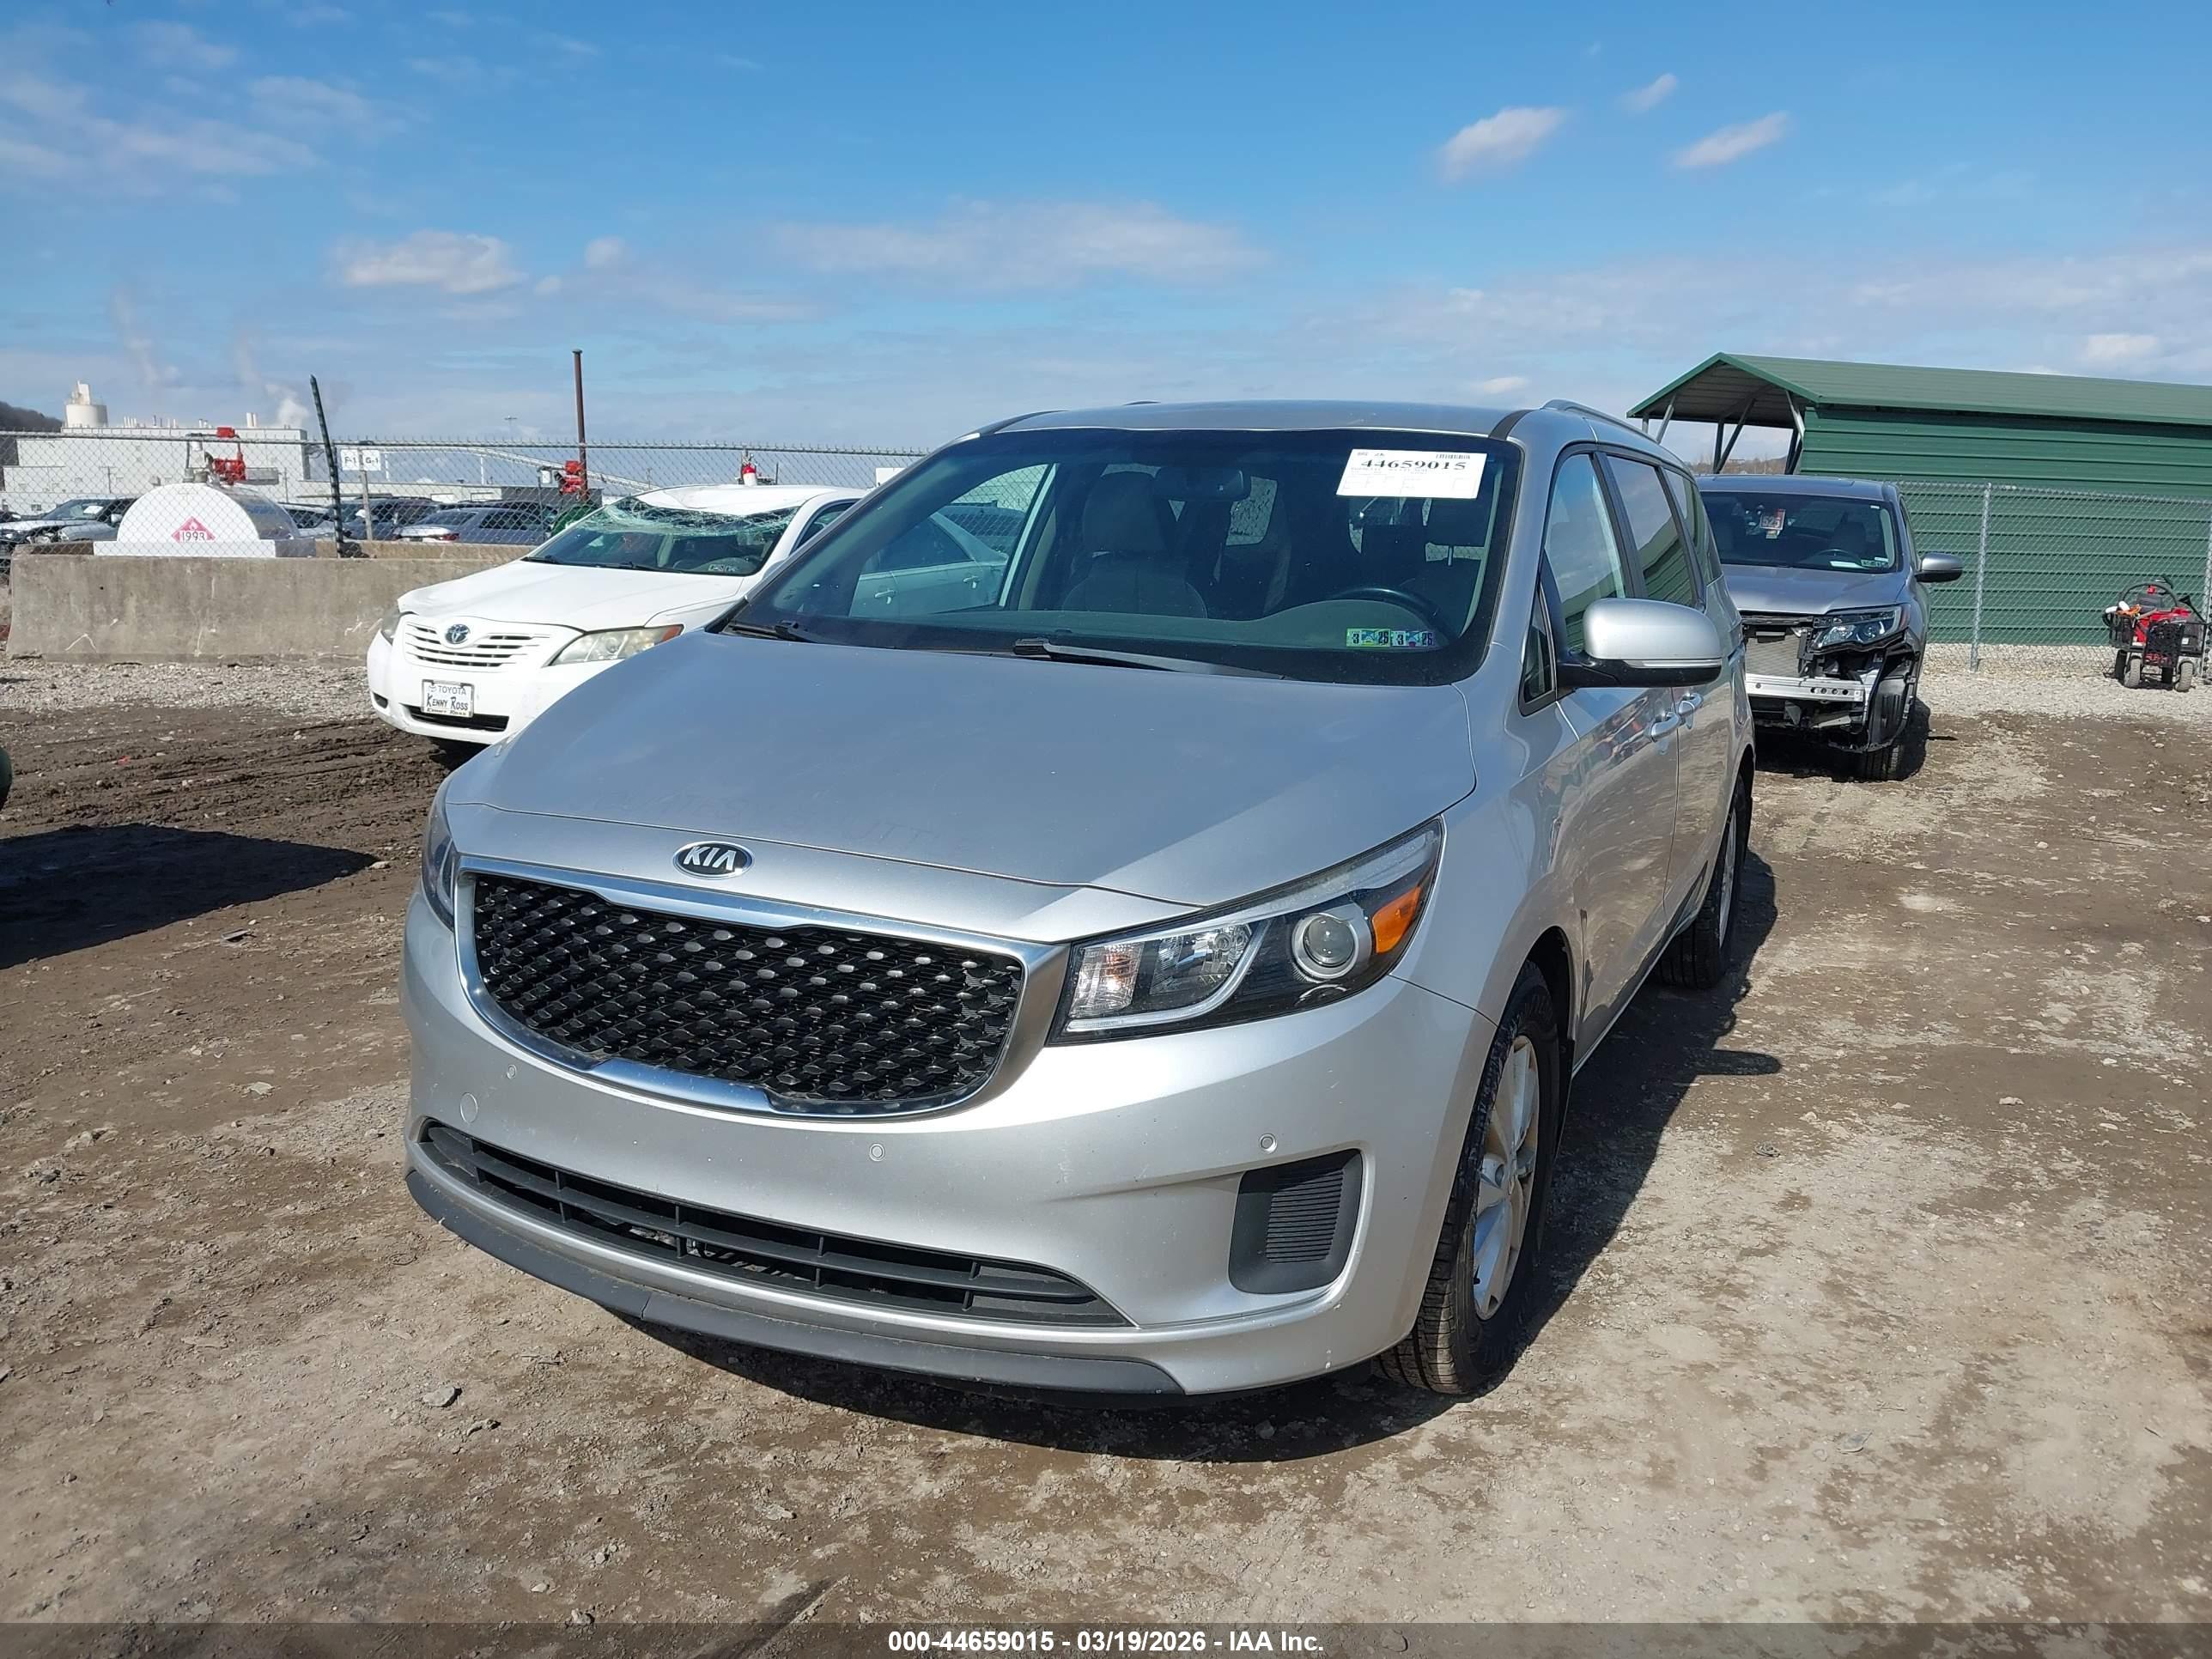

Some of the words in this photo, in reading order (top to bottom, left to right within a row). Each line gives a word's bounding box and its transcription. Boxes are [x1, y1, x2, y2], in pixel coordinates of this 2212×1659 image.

[1361, 459, 1467, 471] 44659015
[438, 685, 466, 696] TOYOTA
[683, 846, 737, 871] KIA
